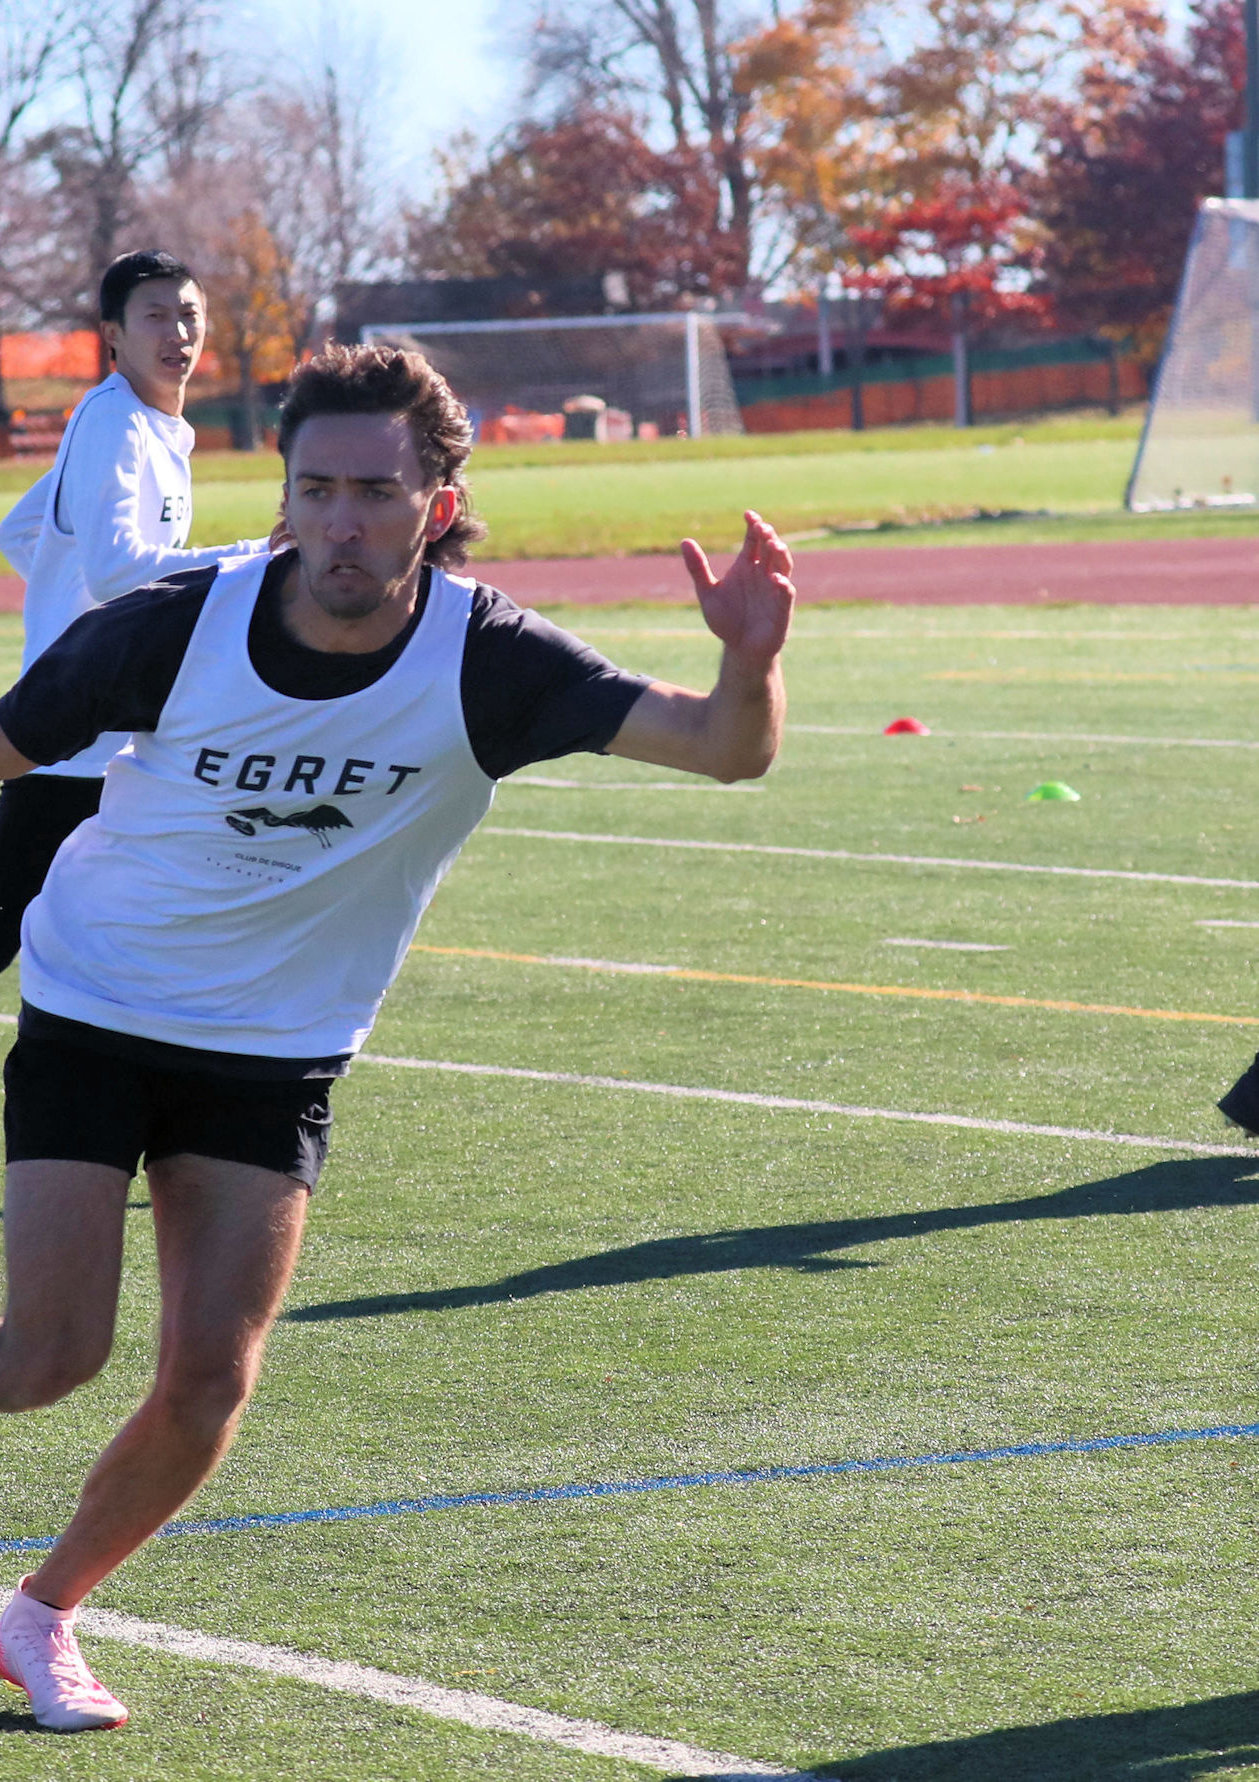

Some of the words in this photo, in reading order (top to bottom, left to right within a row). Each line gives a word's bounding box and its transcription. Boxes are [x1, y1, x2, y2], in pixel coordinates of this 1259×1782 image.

[194, 748, 422, 795] EGRET
[234, 852, 258, 863] CLUB
[259, 857, 270, 867] DE
[271, 859, 302, 873] DISQUE
